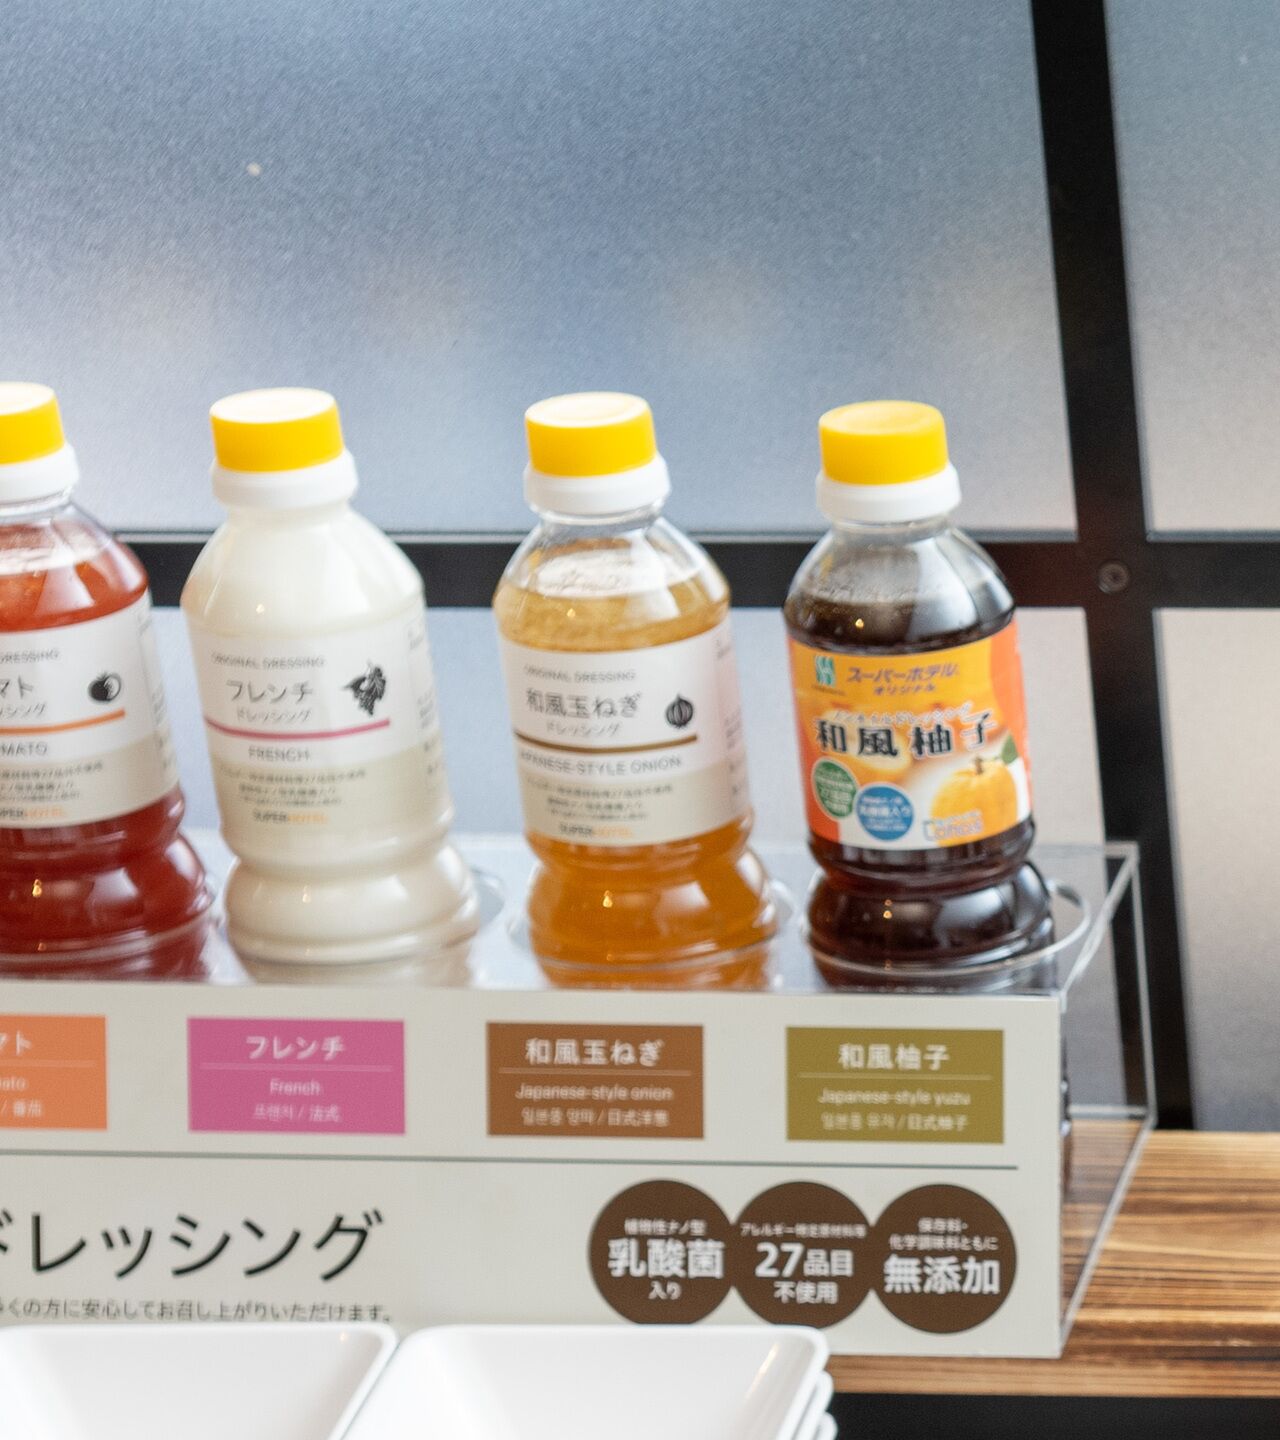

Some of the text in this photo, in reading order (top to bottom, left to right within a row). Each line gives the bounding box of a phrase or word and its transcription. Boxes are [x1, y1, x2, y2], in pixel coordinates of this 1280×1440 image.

[226, 679, 314, 704] フレンチ
[525, 687, 643, 719] 和風玉ねぎ
[817, 712, 997, 758] 和風柚子
[245, 1034, 345, 1061] フレンチ
[525, 1037, 666, 1067] 和風玉ねぎ
[837, 1042, 950, 1072] 和風柚子
[270, 1078, 322, 1096] French
[515, 1082, 674, 1103] Japanese-style onion
[818, 1087, 932, 1108] Japanese-style
[607, 1236, 725, 1280] 乳酸菌
[755, 1242, 854, 1279] 27品目
[883, 1254, 1001, 1296] 無添加
[649, 1280, 683, 1301] 入り
[773, 1281, 839, 1305] 不使用
[0, 1297, 393, 1324] くの方に安心してお召し上がりいただけます。
